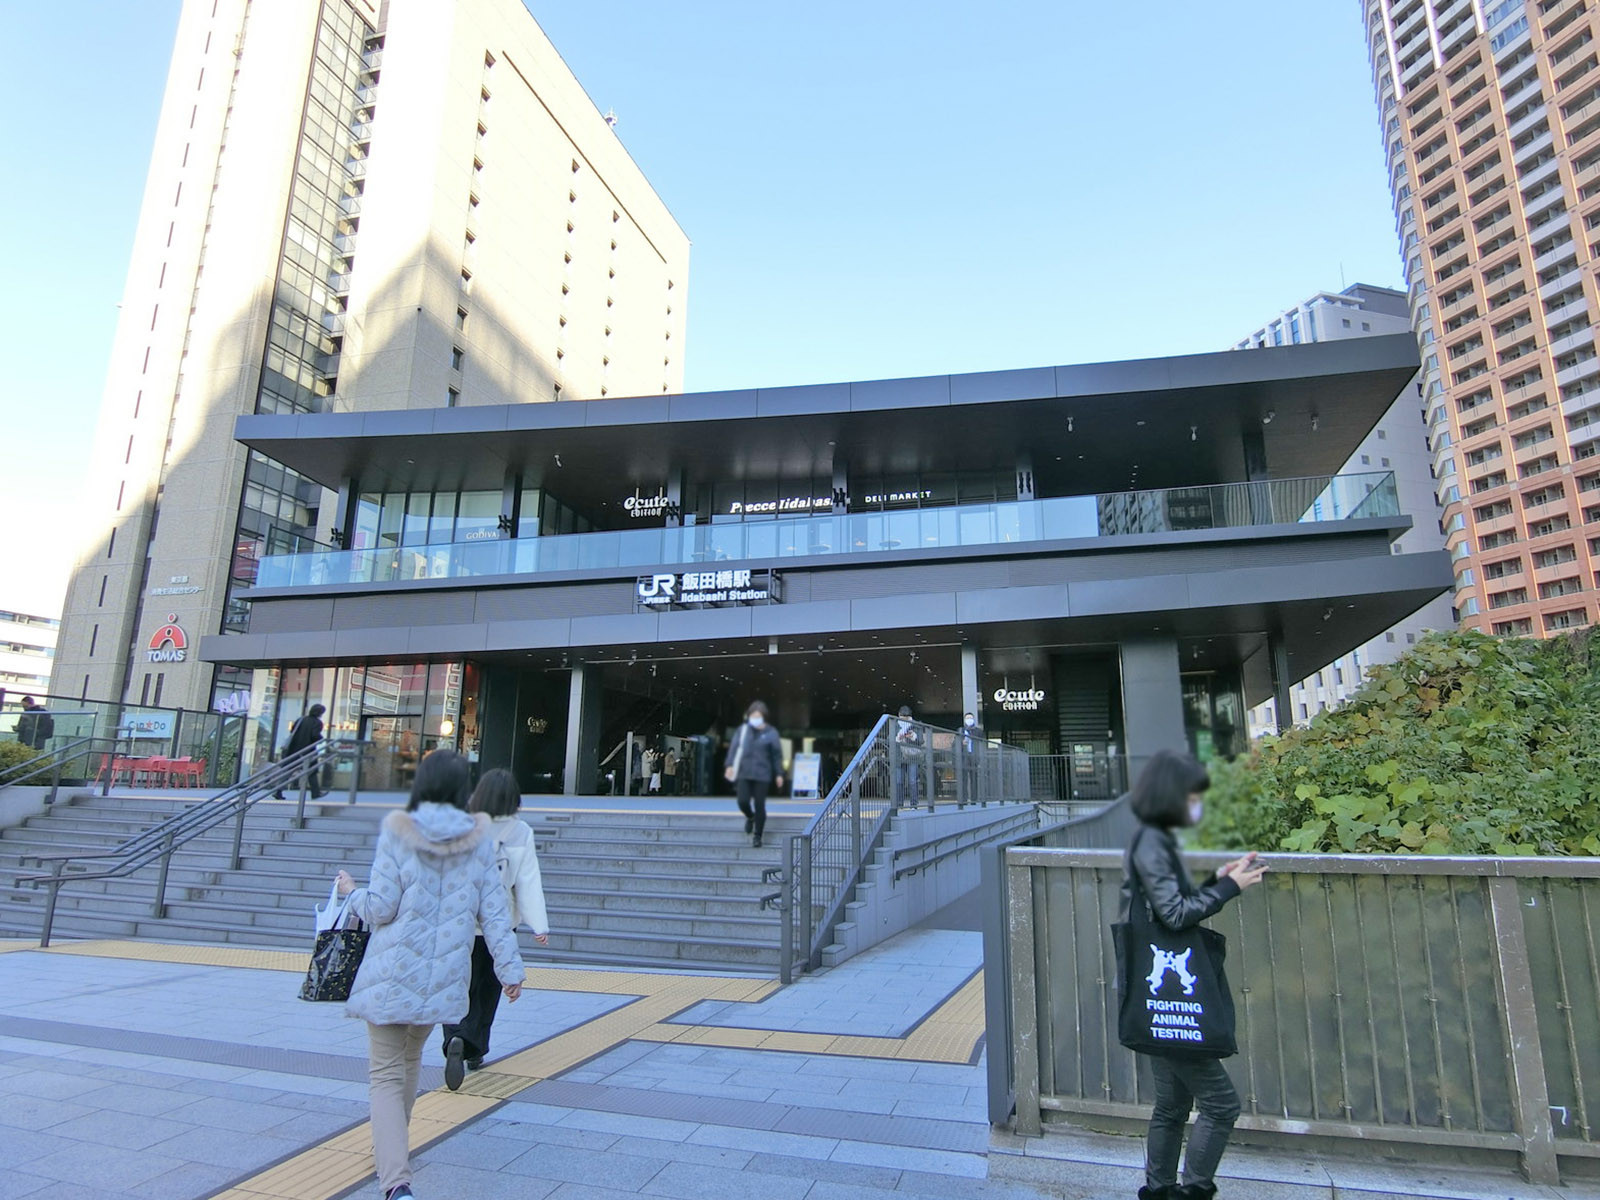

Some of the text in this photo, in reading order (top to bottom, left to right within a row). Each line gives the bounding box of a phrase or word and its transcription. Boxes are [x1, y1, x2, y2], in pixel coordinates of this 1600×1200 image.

[624, 495, 669, 510] ecute
[779, 496, 850, 510] Iidabas
[865, 490, 931, 503] DELI MARKET
[630, 508, 662, 518] EDITION
[466, 530, 497, 540] GODIVA
[639, 574, 675, 597] JR
[682, 569, 751, 590] 飯田橋駅
[681, 589, 767, 602] Iidabashi Station
[147, 650, 186, 662] TOMAS
[994, 688, 1045, 702] ecute
[1002, 701, 1038, 710] EDITION
[1146, 999, 1203, 1013] FIGHTING
[1152, 1013, 1200, 1027] ANIMAL
[1150, 1027, 1203, 1041] TESTING
